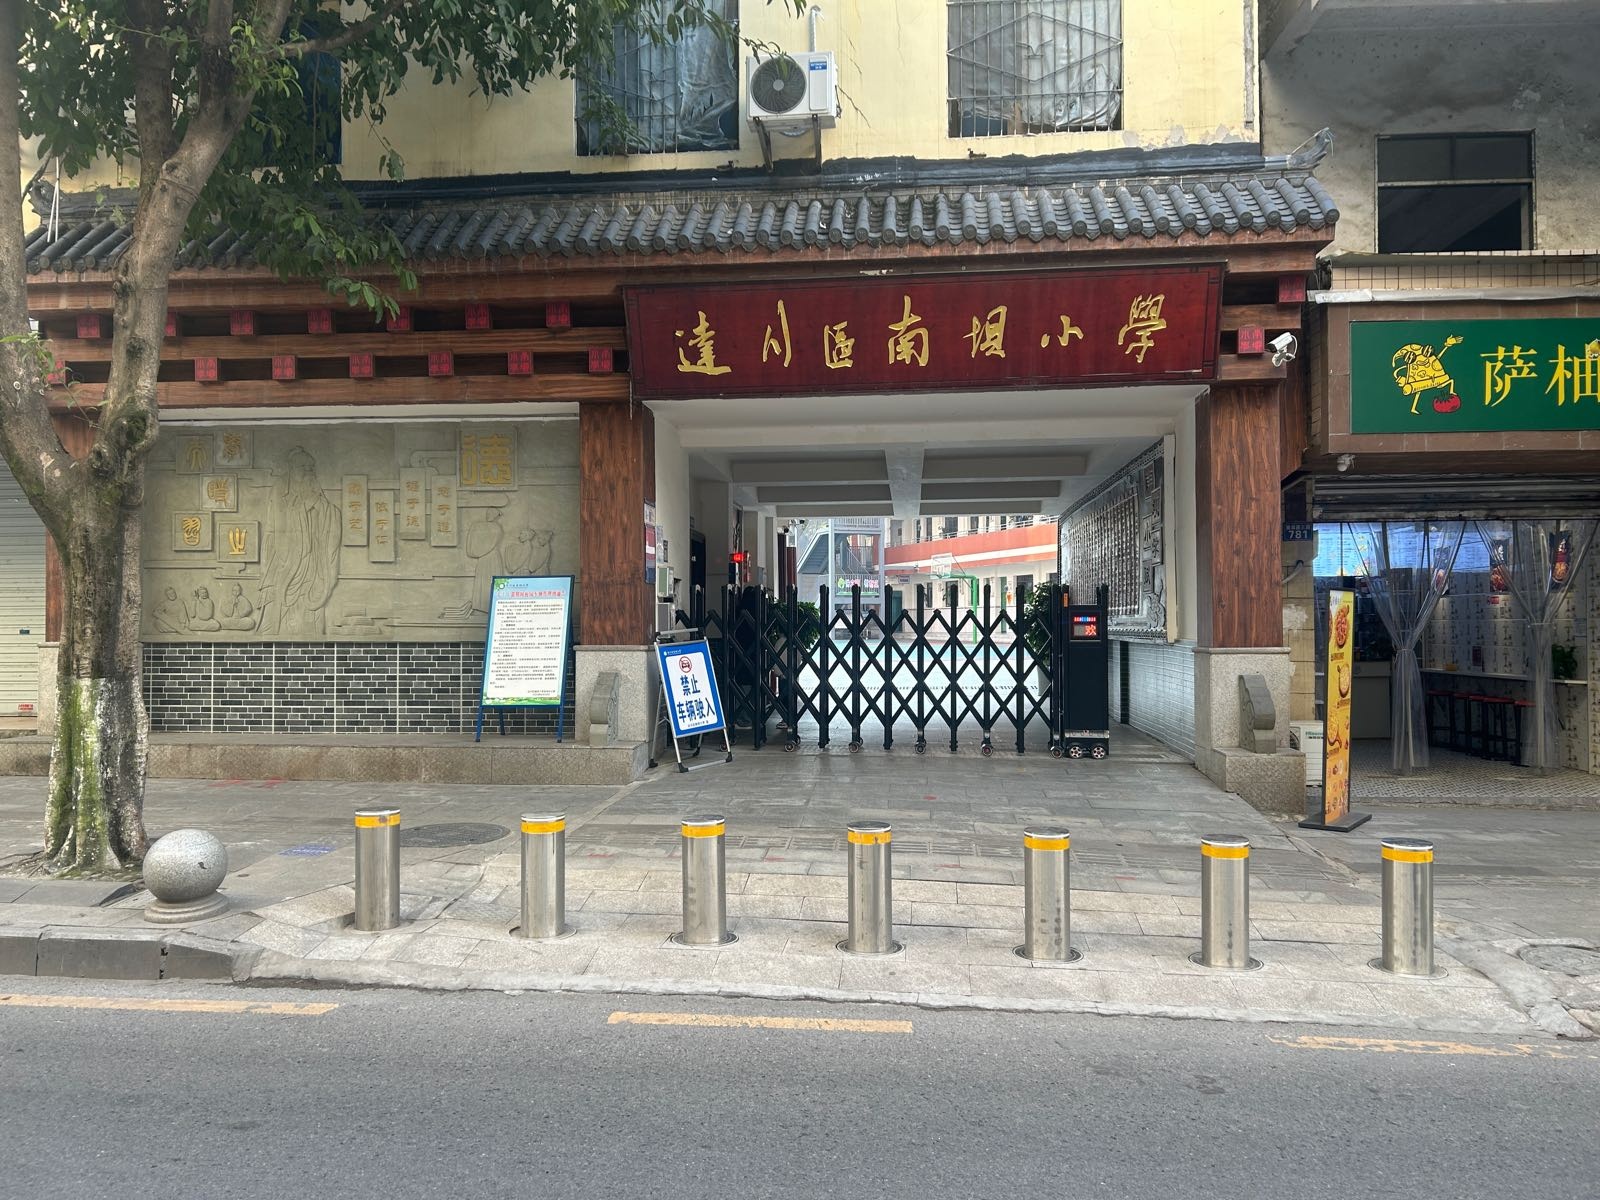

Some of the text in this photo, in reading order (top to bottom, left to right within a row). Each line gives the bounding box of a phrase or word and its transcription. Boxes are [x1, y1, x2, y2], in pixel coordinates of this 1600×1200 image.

[1480, 344, 1600, 406] 萨柚
[1288, 530, 1308, 539] 781
[680, 674, 701, 696] 禁止
[677, 697, 716, 723] 车辆驶入
